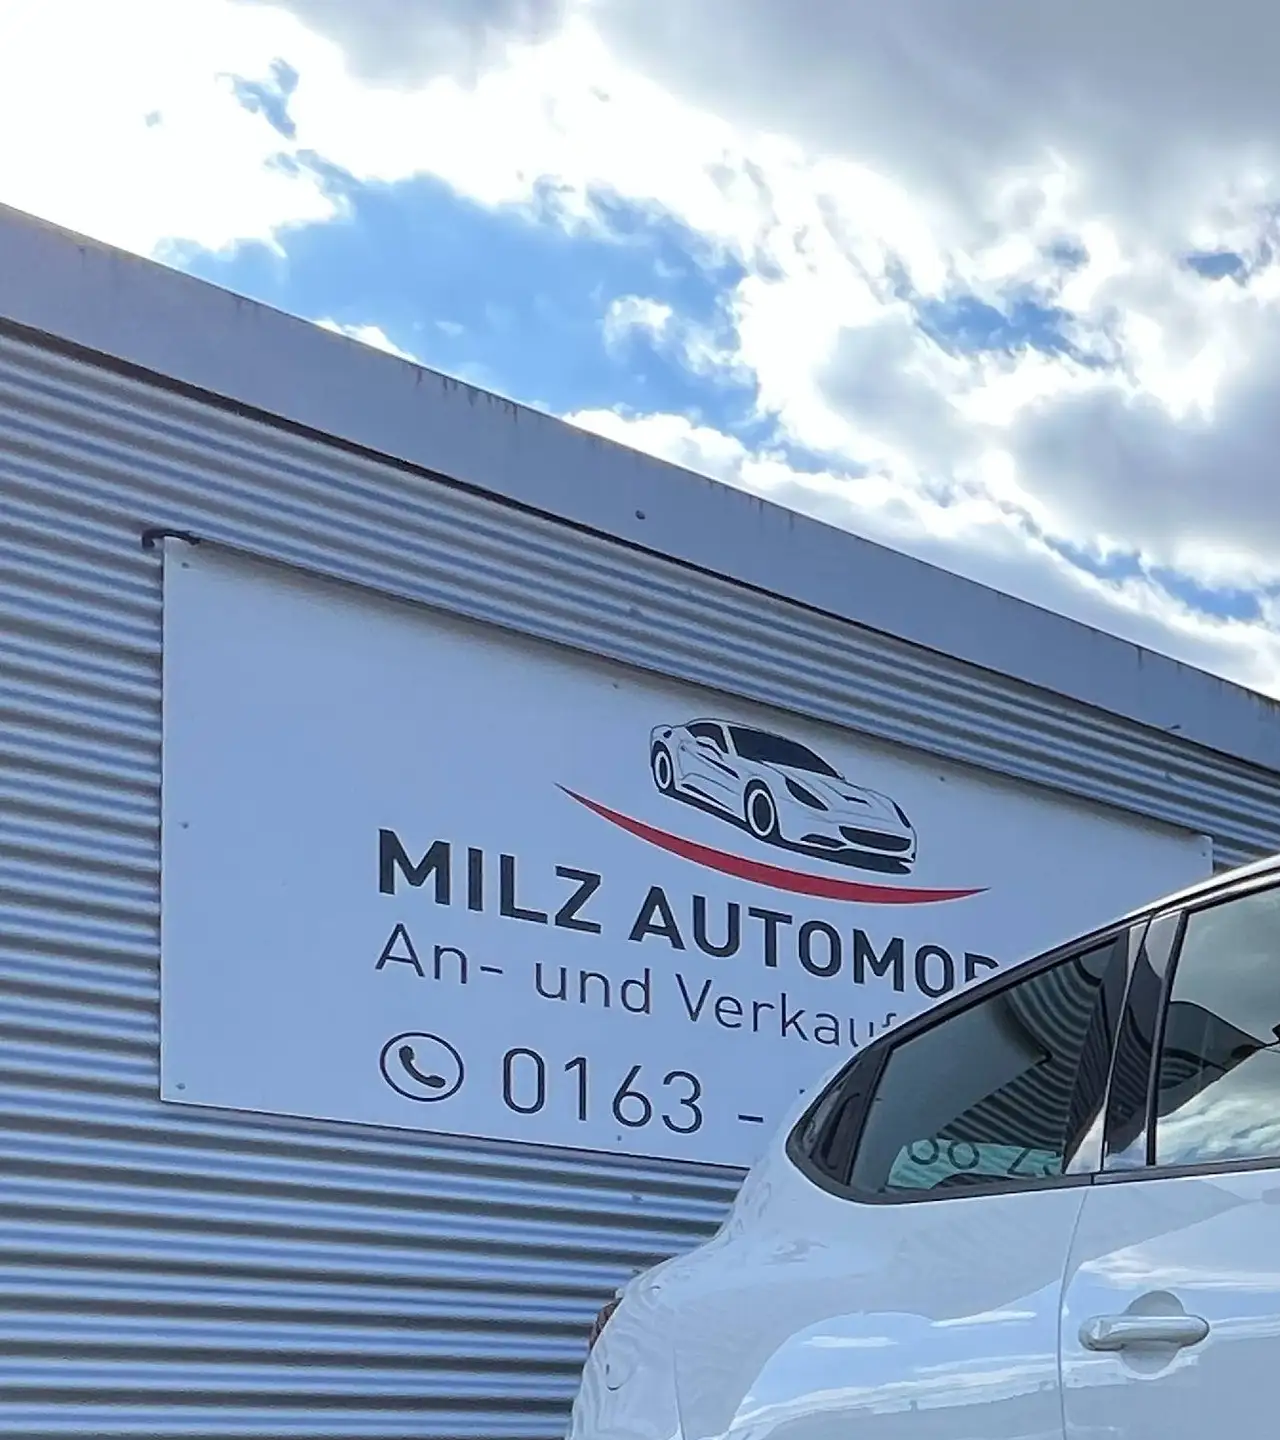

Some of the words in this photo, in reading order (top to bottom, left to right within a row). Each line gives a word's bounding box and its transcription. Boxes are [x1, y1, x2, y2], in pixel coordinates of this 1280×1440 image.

[378, 827, 602, 935] MILZ
[375, 922, 504, 985] An-
[534, 961, 652, 1016] und
[502, 1047, 703, 1135] 0163
